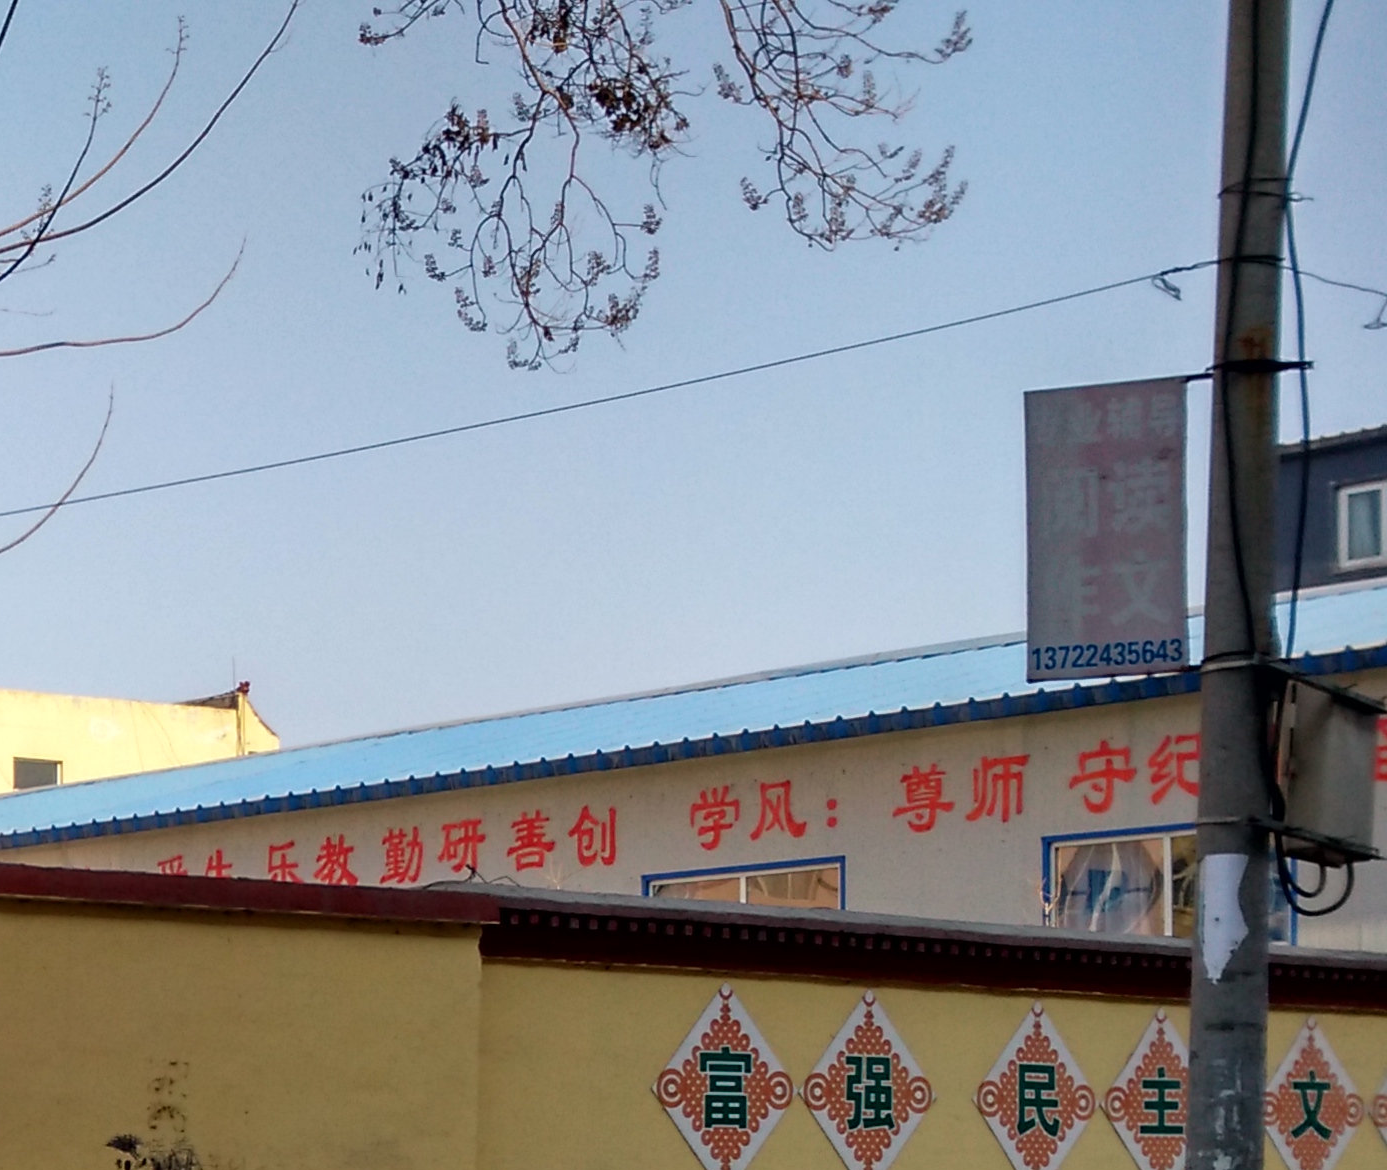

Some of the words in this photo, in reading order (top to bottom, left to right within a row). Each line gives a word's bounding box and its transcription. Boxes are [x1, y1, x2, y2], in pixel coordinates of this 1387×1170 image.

[1035, 548, 1175, 640] 作文
[1031, 638, 1183, 671] 13722435643
[892, 754, 1030, 833] 尊师
[1068, 733, 1202, 816] 守纪
[697, 1046, 896, 1132] 富强
[1015, 1062, 1185, 1139] 民主
[1291, 1069, 1333, 1142] 文
